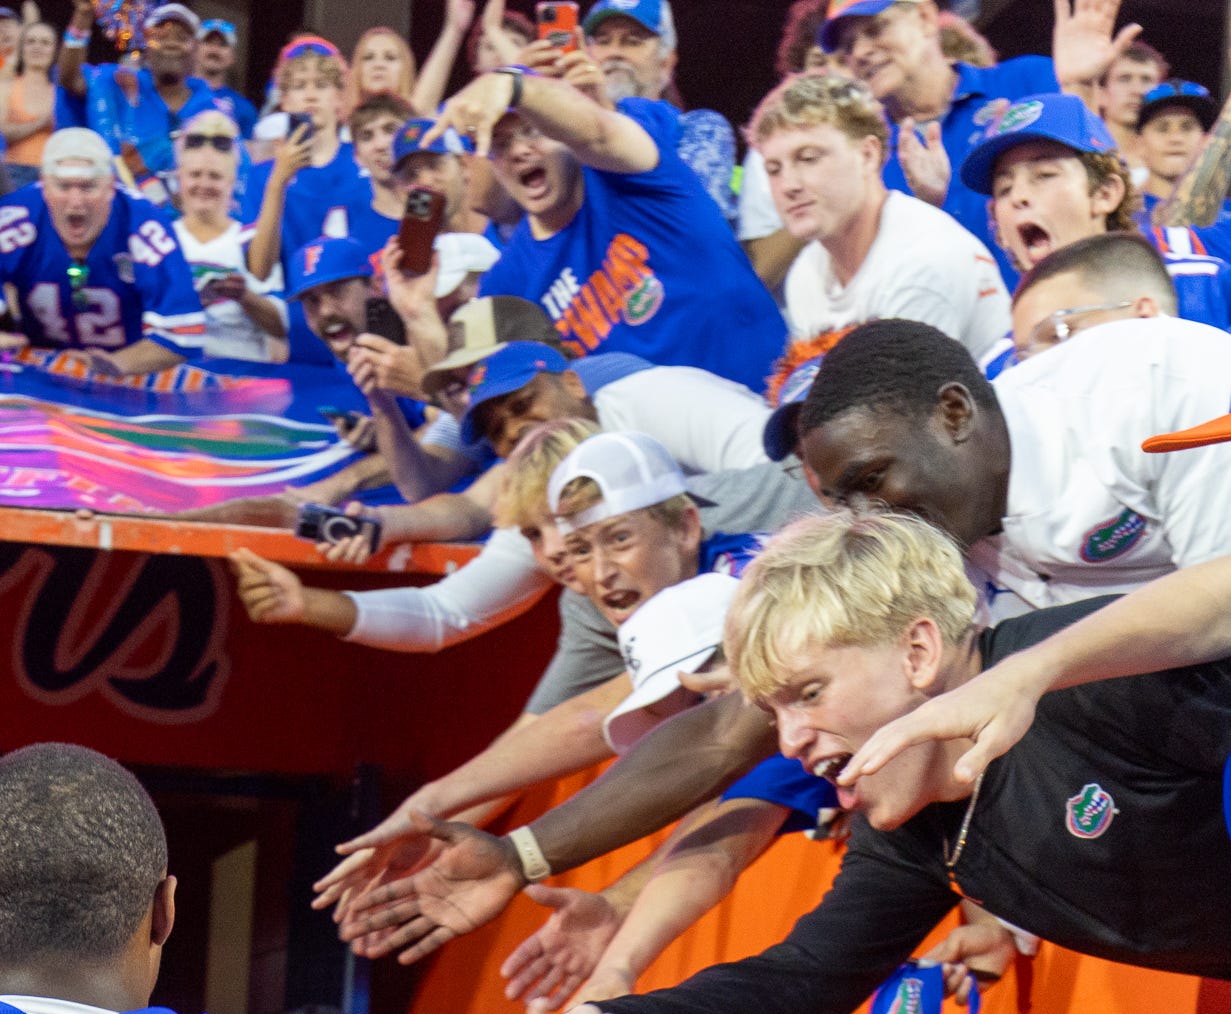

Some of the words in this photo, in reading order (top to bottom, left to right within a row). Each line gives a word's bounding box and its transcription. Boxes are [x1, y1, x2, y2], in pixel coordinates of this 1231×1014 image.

[127, 220, 178, 267] 42
[25, 281, 127, 347] 42
[540, 266, 581, 320] THE
[554, 232, 650, 358] SWAMP
